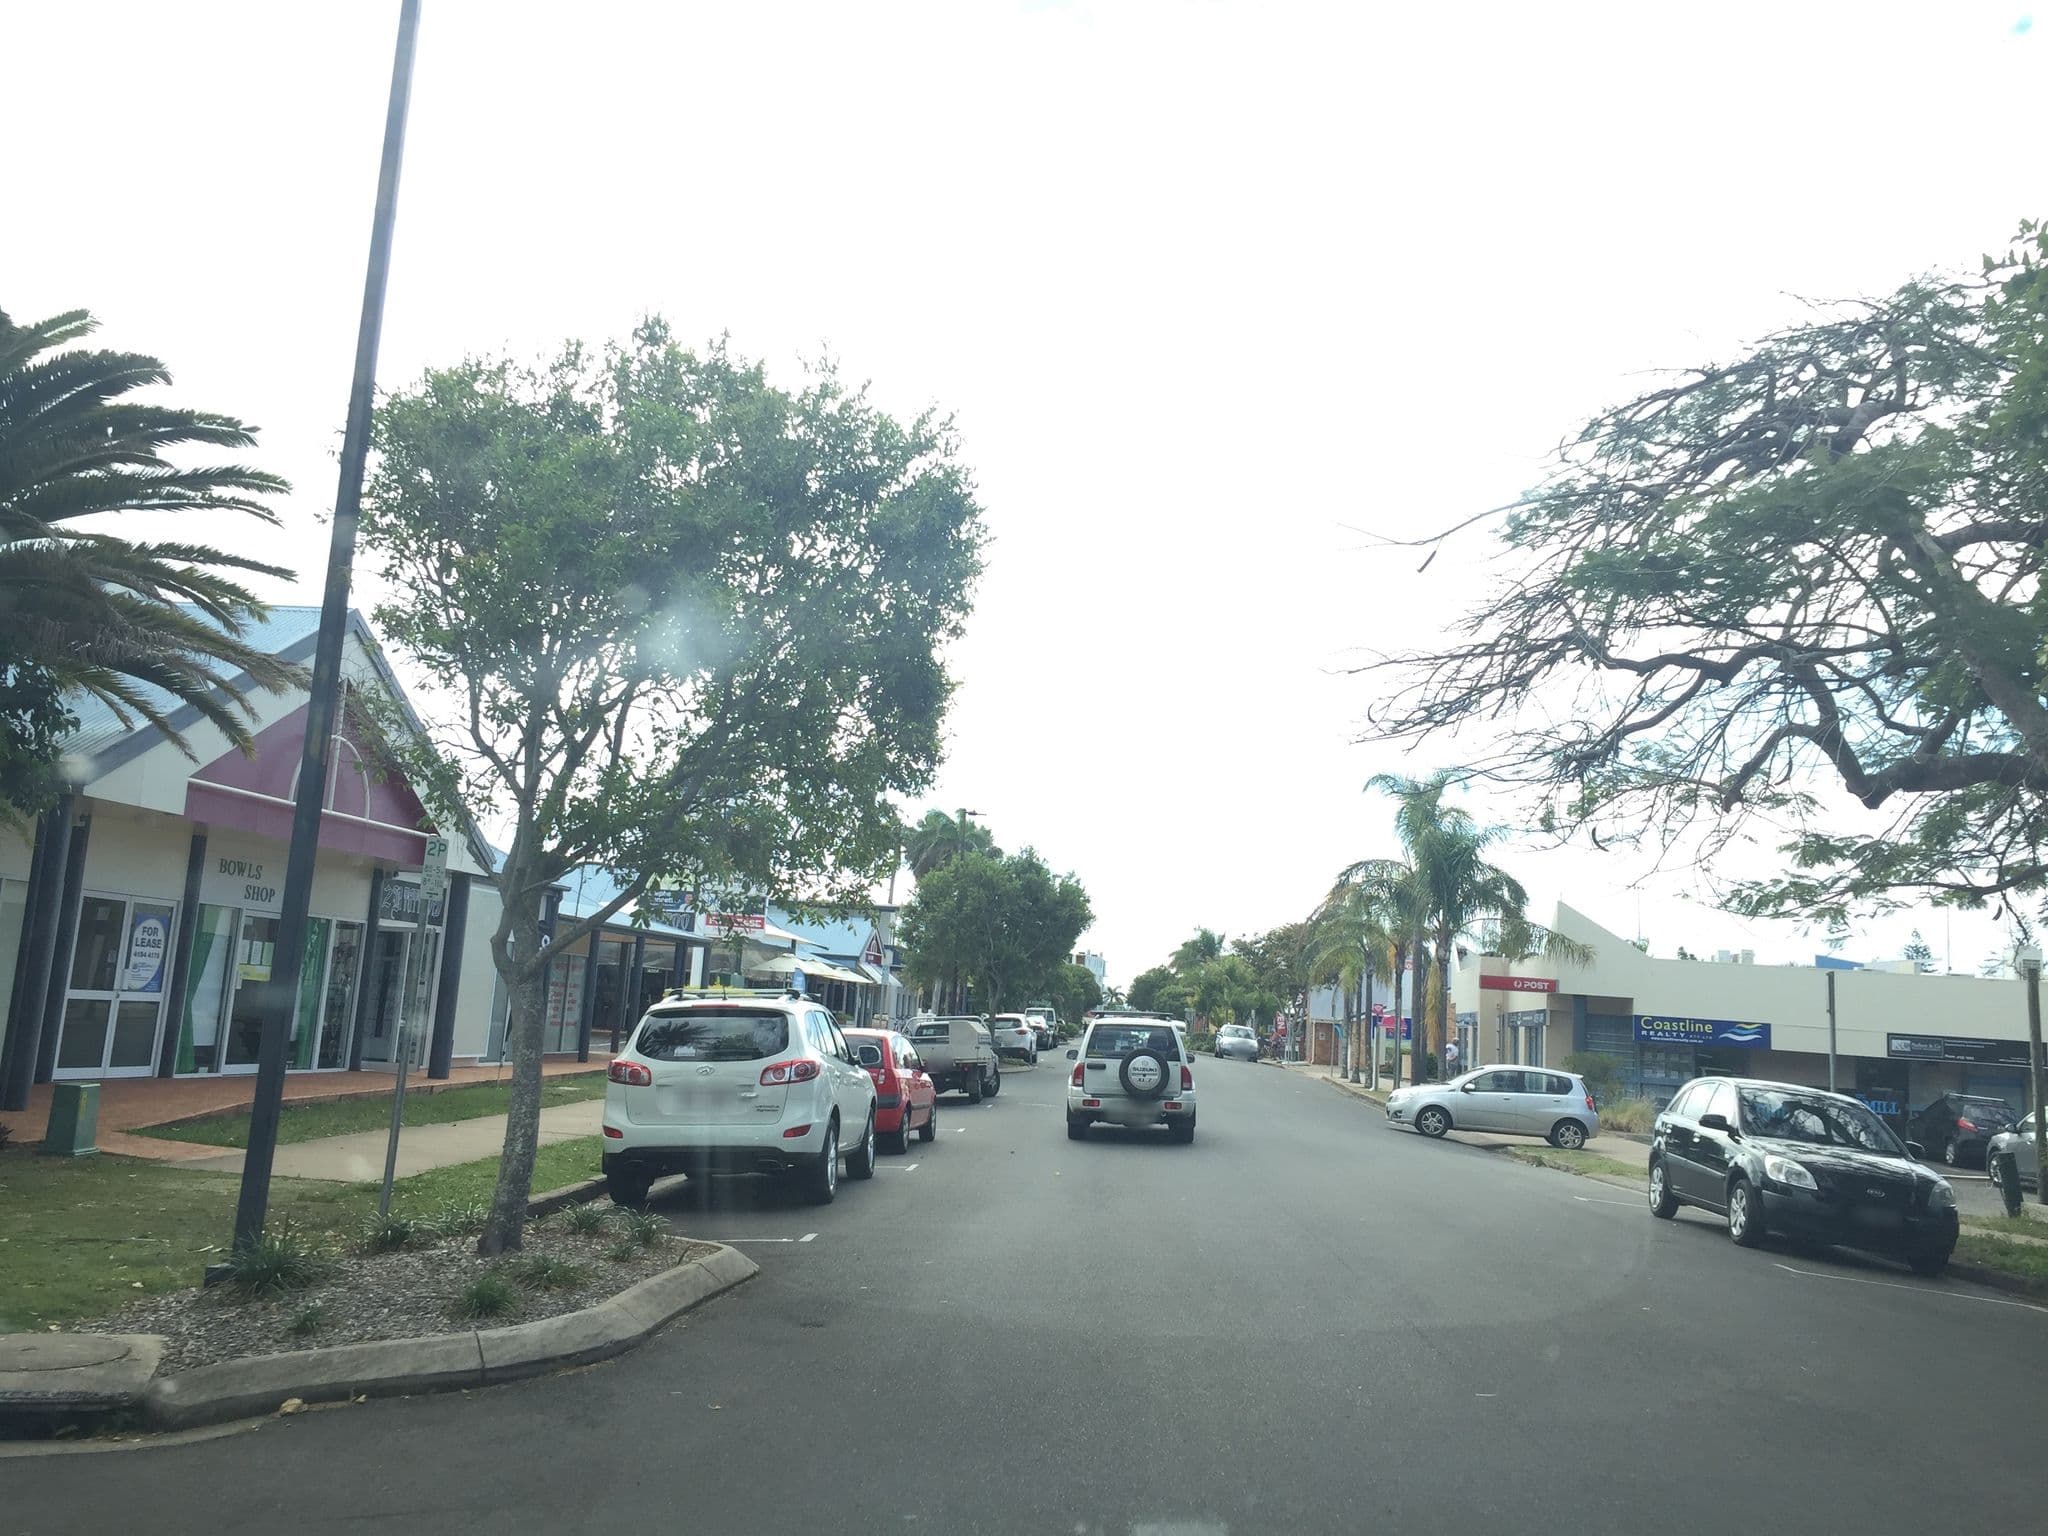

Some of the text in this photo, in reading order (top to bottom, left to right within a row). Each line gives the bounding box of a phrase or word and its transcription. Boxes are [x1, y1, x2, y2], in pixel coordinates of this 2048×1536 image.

[427, 841, 447, 856] 2P
[219, 858, 263, 880] BOWLS
[244, 884, 276, 902] SHOP
[141, 926, 159, 937] FOR
[135, 937, 162, 949] LEASE
[1523, 981, 1549, 990] POST
[1640, 1016, 1713, 1033] Coastline
[1641, 1030, 1686, 1038] REALTY
